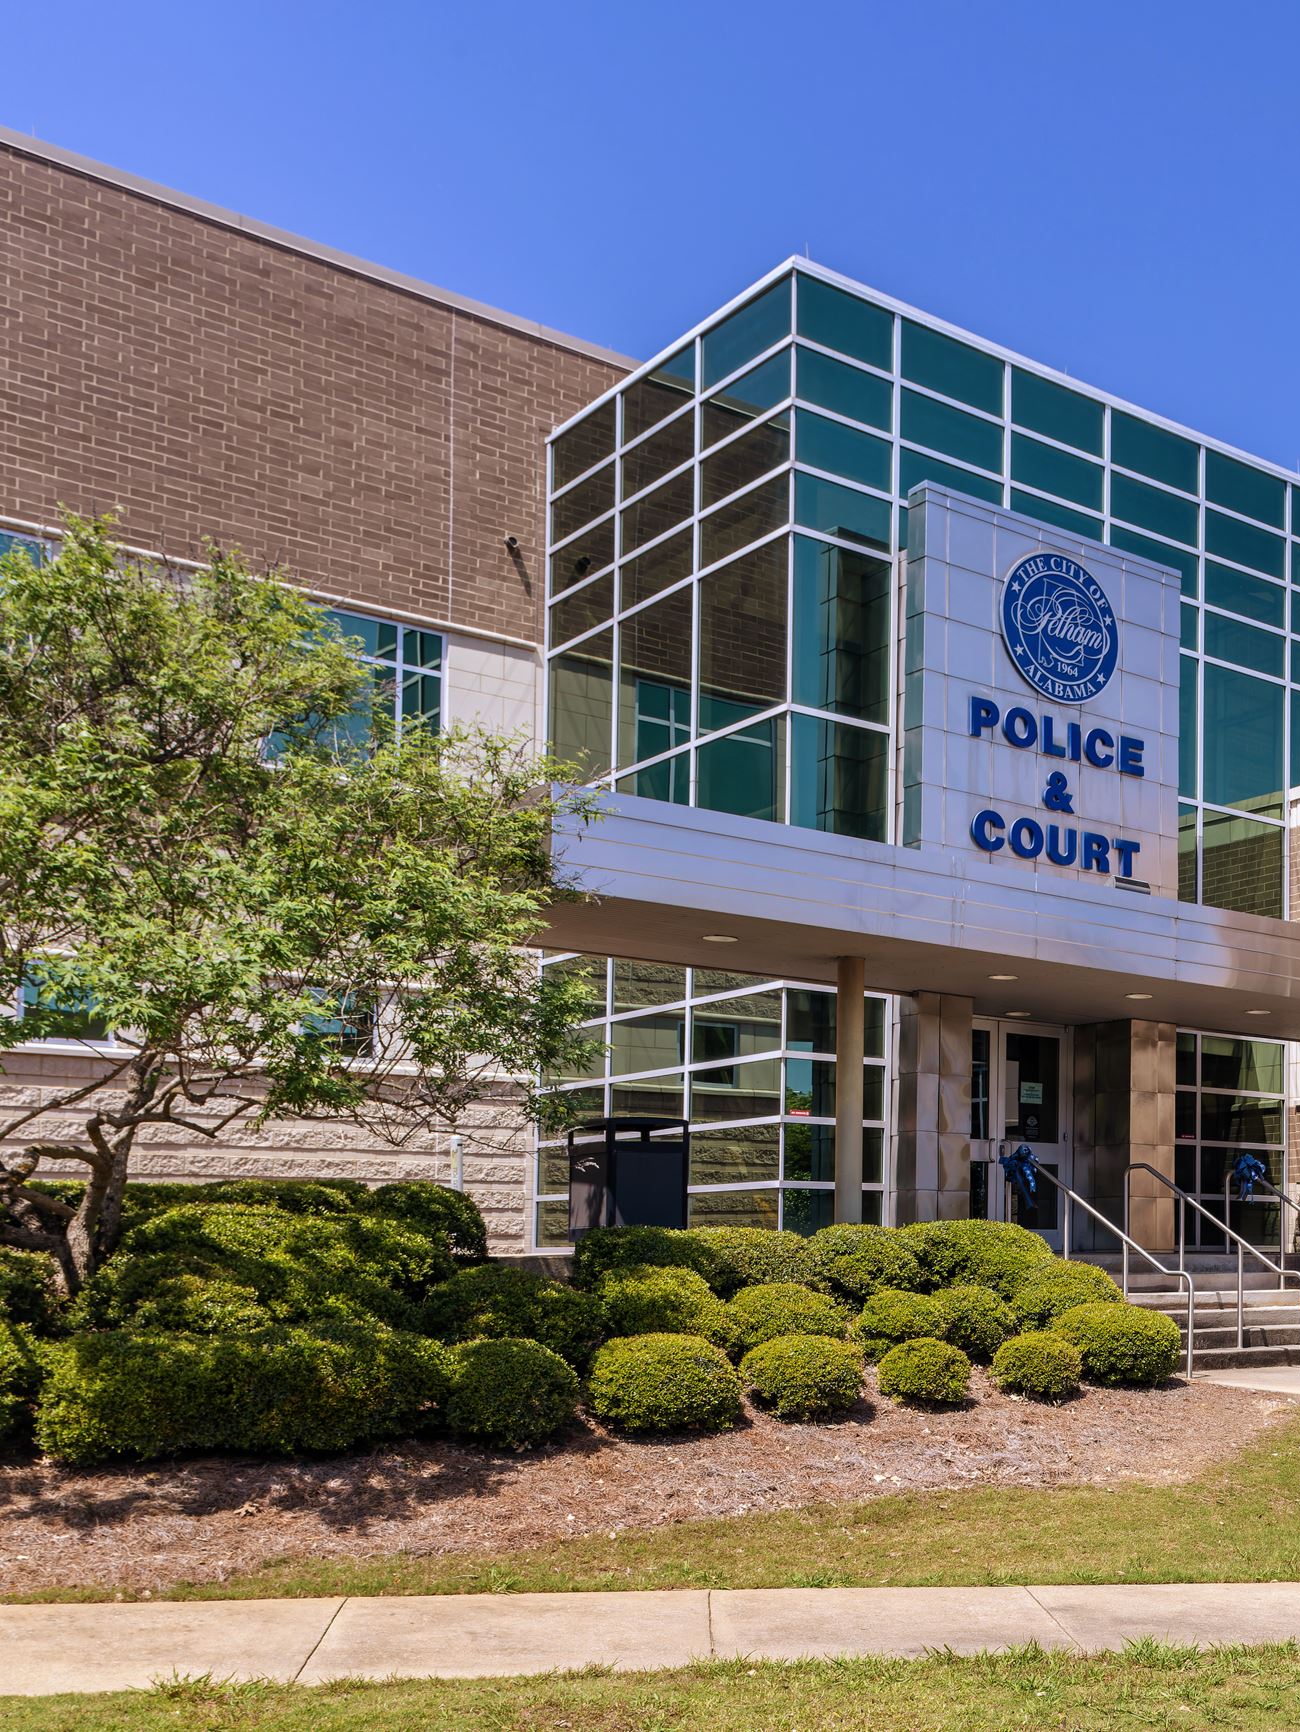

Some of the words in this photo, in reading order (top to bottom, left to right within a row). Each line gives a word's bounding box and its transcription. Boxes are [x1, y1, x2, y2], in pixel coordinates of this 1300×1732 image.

[1017, 557, 1047, 582] THE
[1050, 557, 1089, 584] CITY
[1089, 585, 1109, 609] OF
[1011, 588, 1110, 655] Pelham
[1024, 664, 1096, 699] ALABAMA
[1057, 663, 1078, 677] 1964
[969, 696, 1144, 777] POLICE
[1042, 771, 1075, 814] &
[971, 810, 1140, 877] COURT
